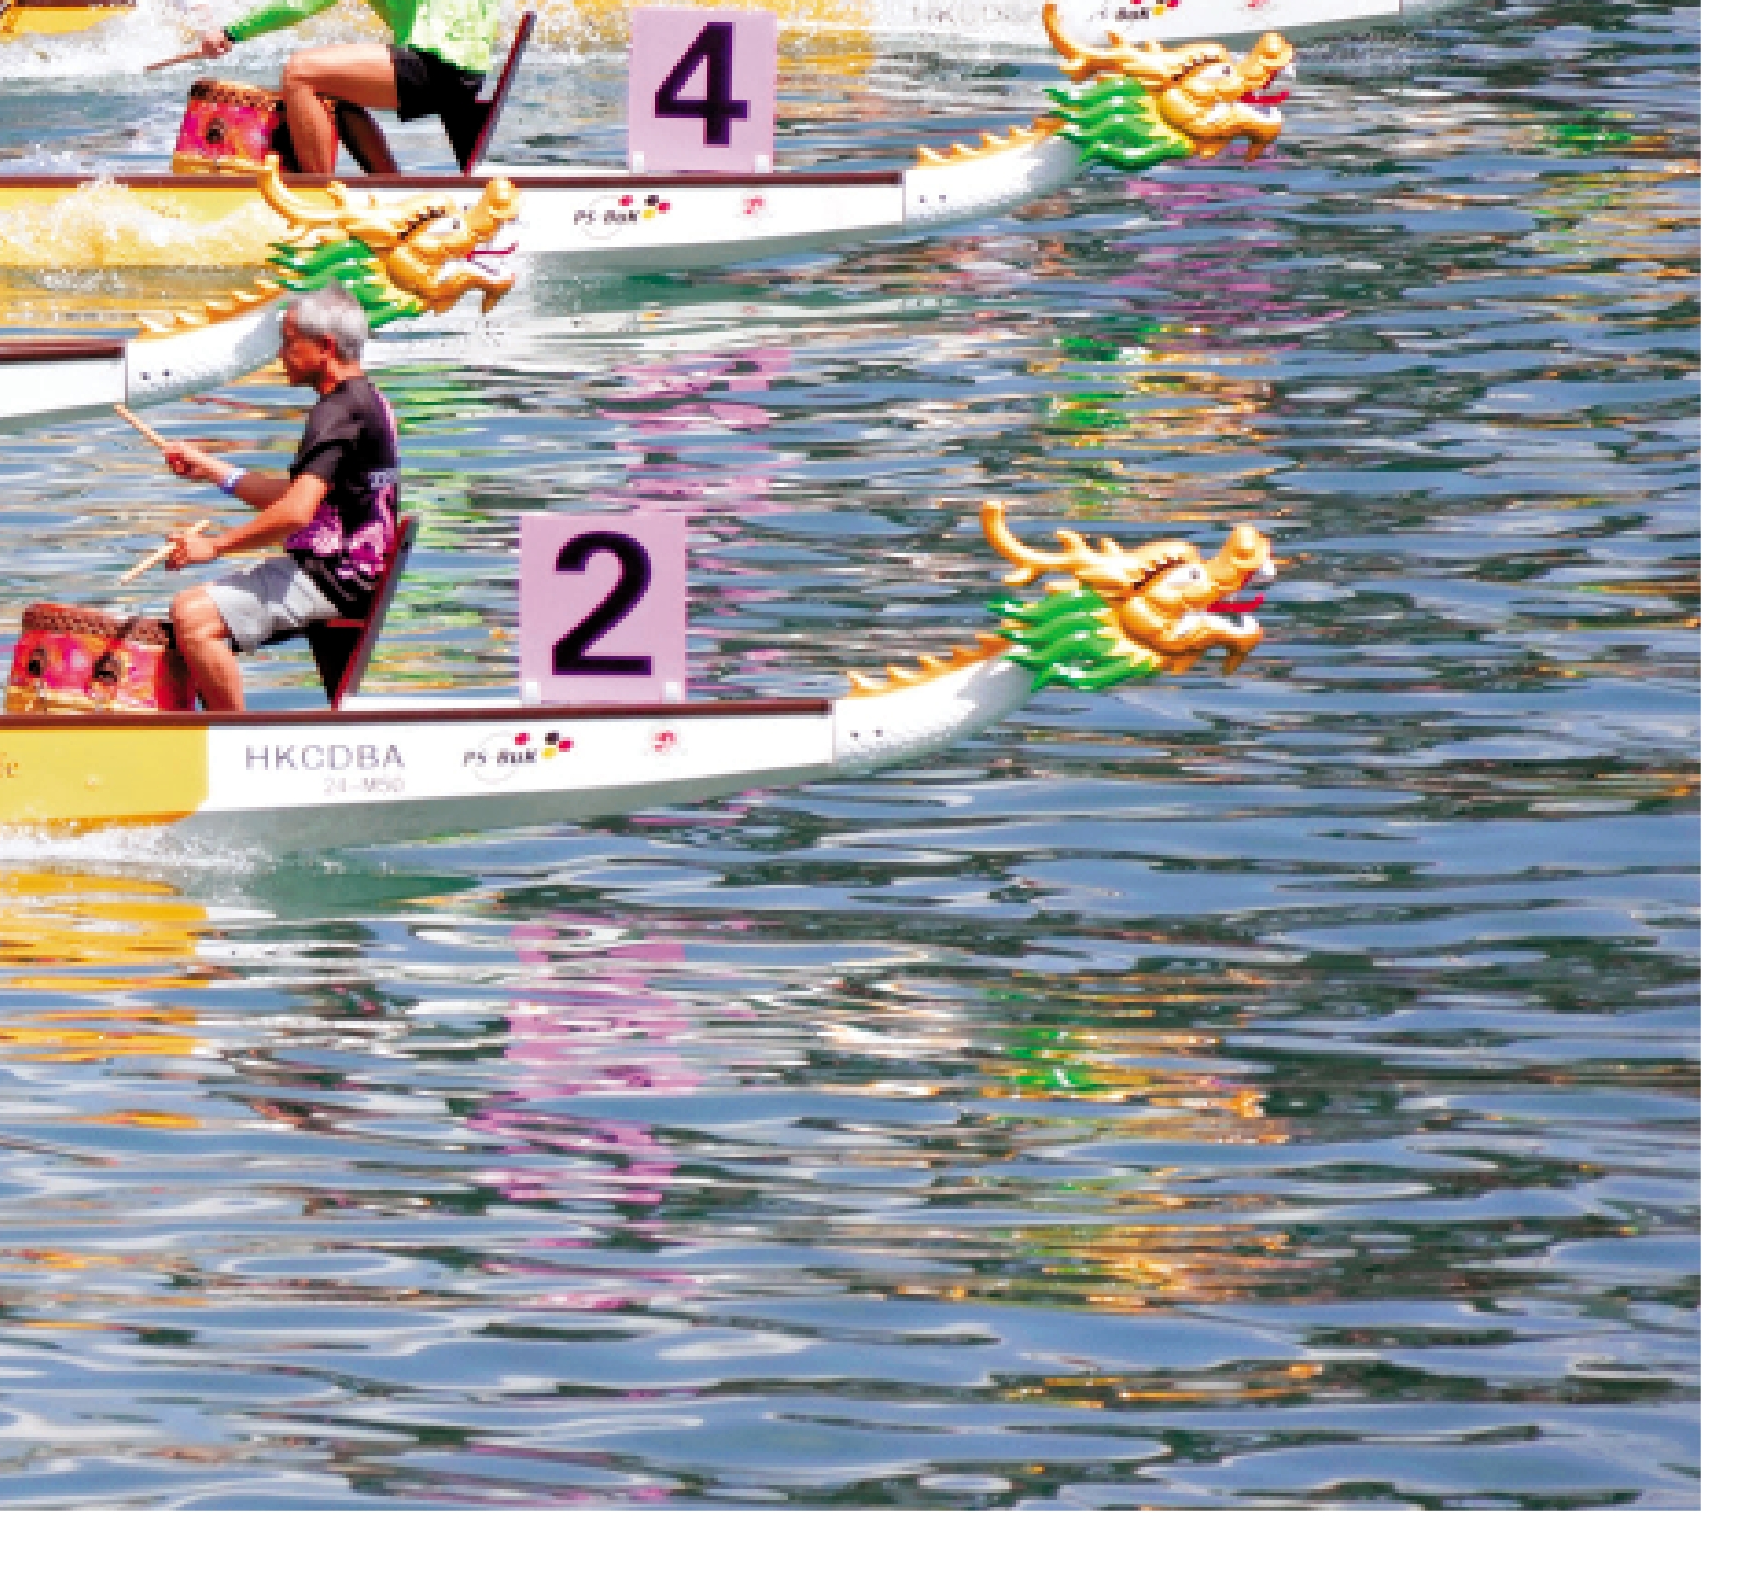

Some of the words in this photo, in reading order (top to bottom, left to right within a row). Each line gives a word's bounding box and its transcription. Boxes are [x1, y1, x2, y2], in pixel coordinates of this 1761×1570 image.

[654, 21, 748, 148] 4
[552, 530, 652, 676] 2
[246, 745, 405, 770] HKCDBA
